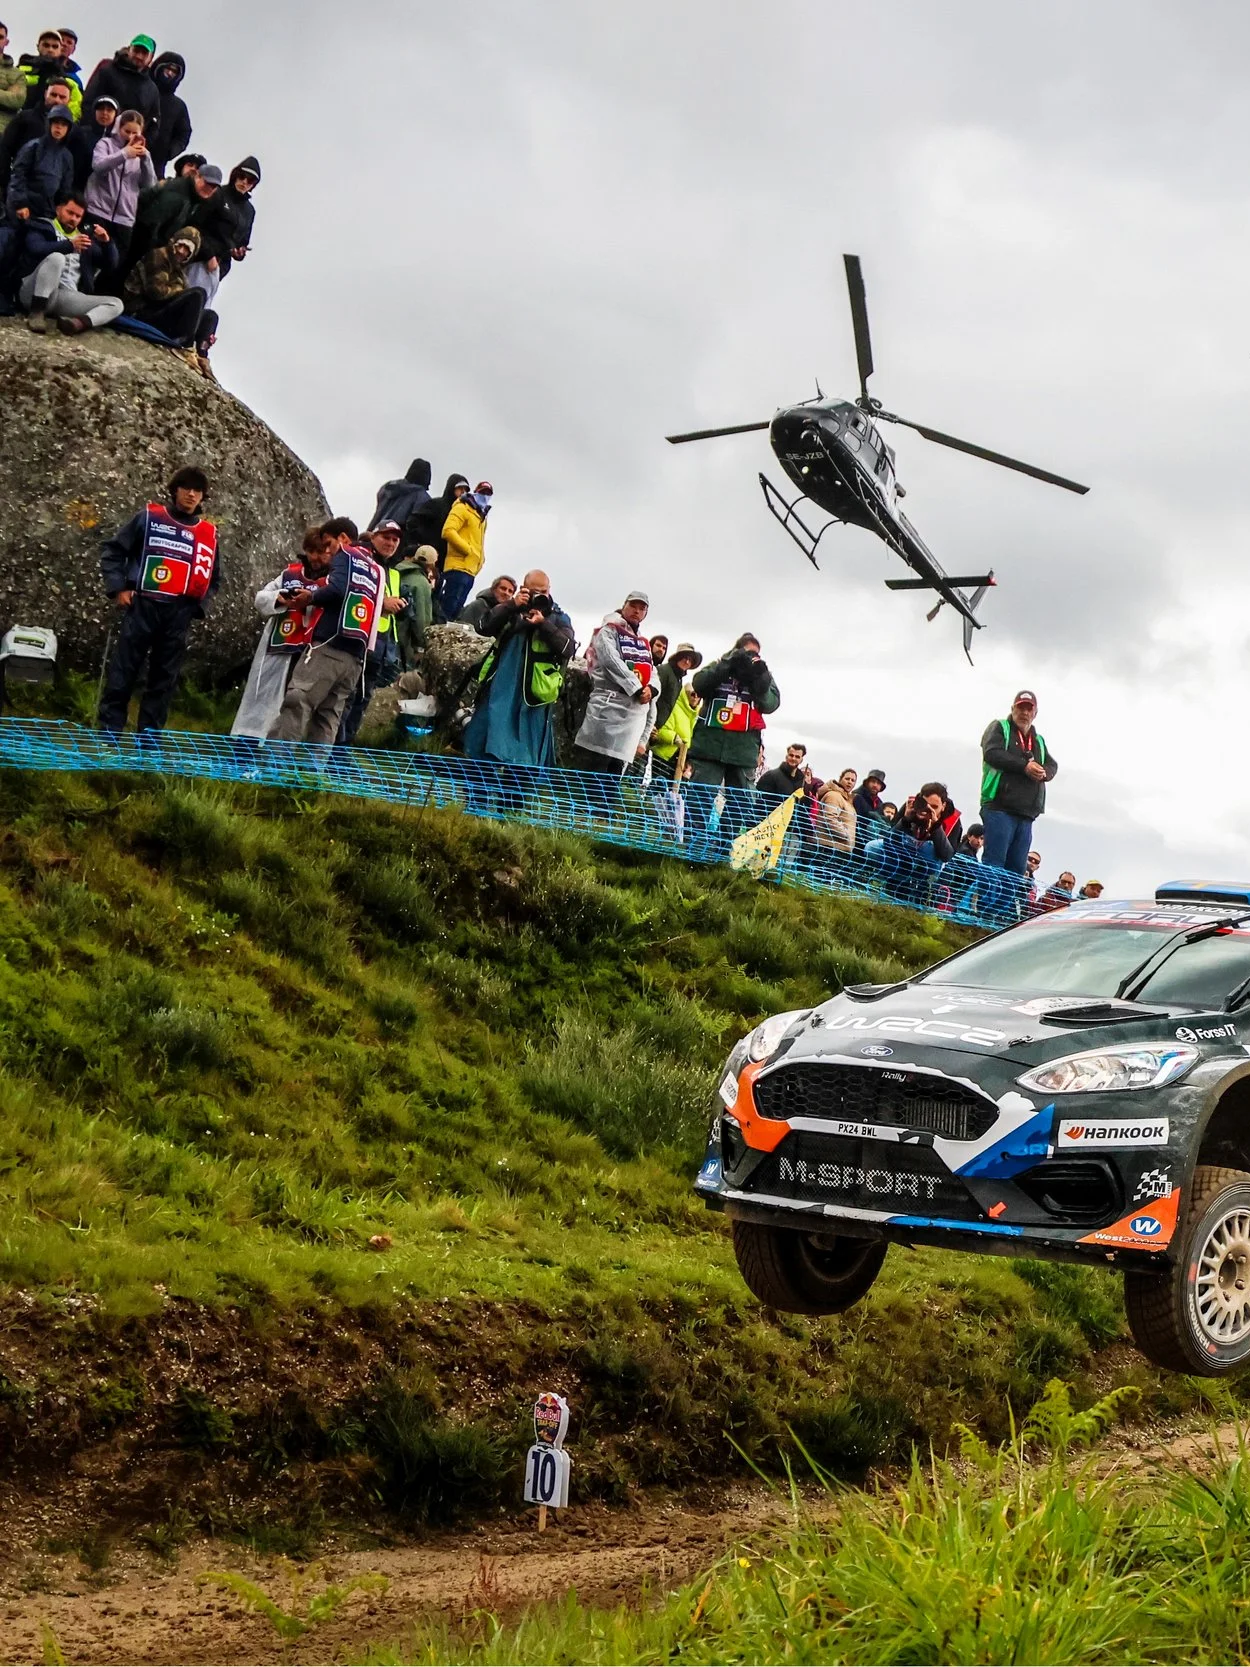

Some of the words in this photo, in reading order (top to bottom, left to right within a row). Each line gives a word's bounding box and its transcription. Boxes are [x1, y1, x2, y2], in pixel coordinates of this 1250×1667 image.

[194, 542, 214, 579] 237
[825, 1015, 1007, 1047] WRC2
[838, 1123, 858, 1135] PX24
[861, 1126, 877, 1137] BWL
[1135, 1219, 1160, 1233] W
[531, 1451, 556, 1502] 10
